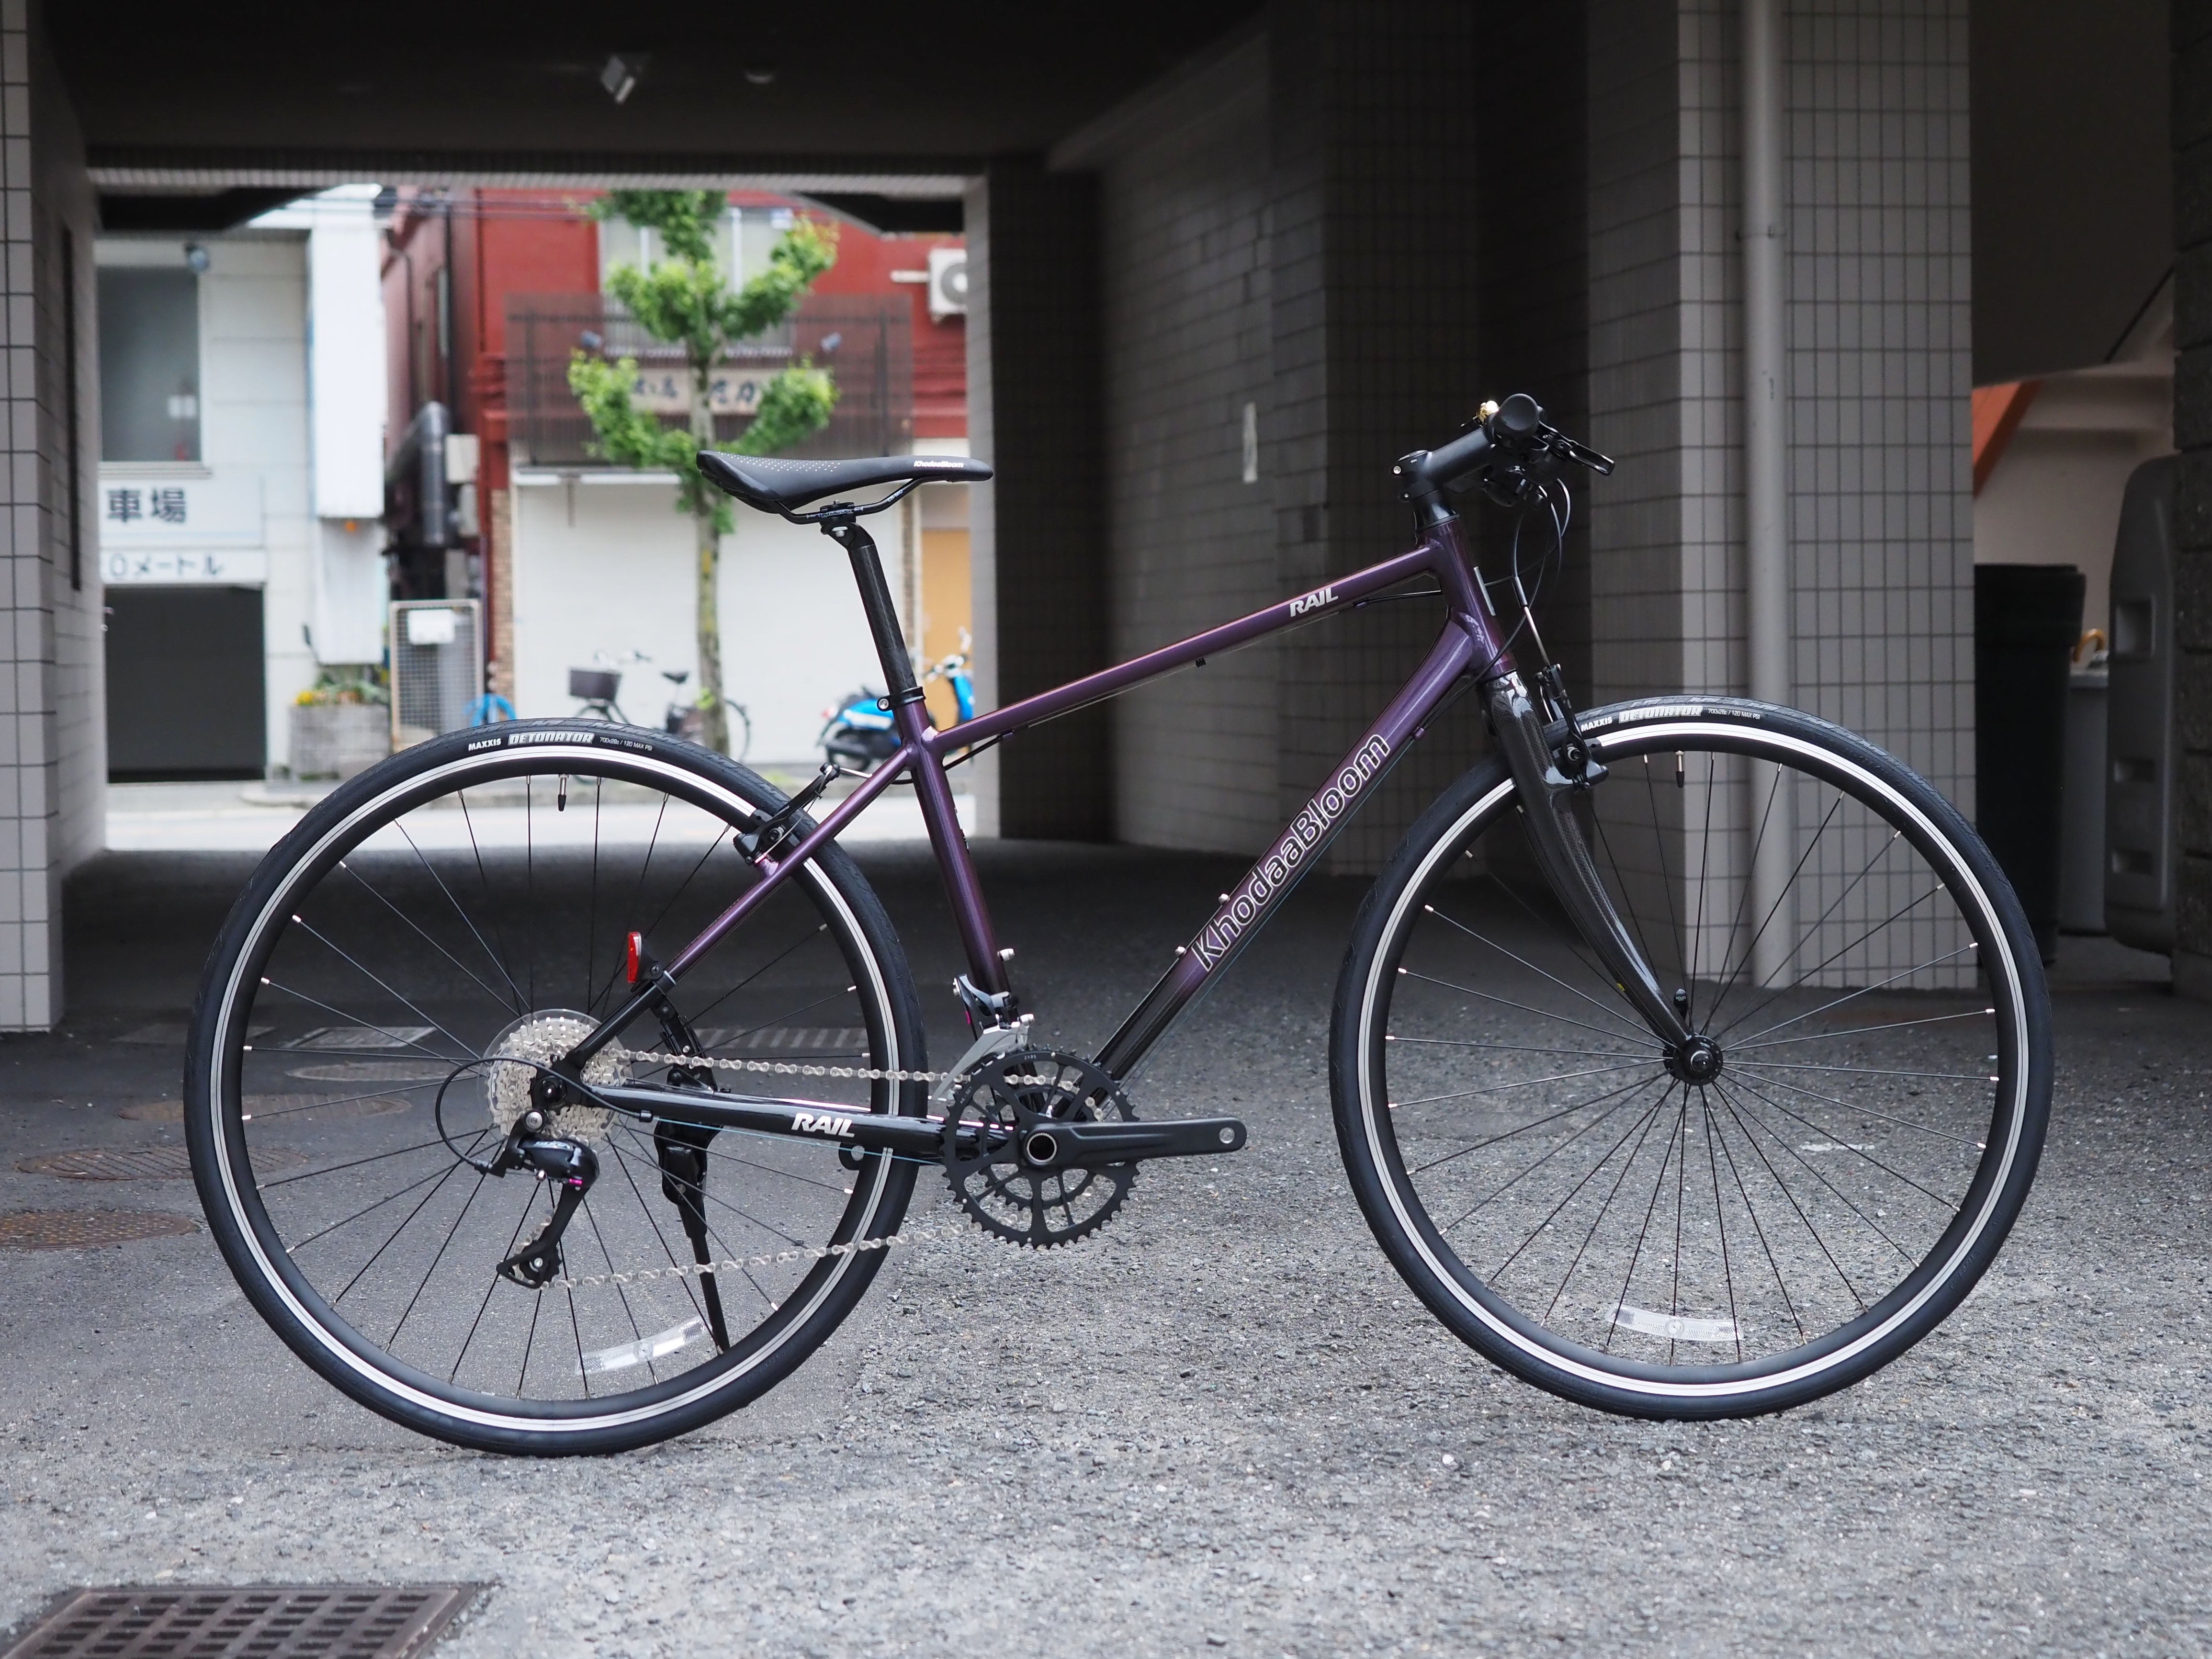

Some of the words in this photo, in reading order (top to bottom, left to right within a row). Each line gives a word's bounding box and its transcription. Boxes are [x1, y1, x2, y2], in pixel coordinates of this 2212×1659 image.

[1289, 587, 1339, 617] RAIL
[1580, 716, 1613, 732] MAXXIS
[1619, 706, 1704, 723] DETONATOR
[468, 738, 501, 751] MAXXIS
[508, 731, 595, 746] DETONATOR
[1191, 734, 1390, 972] KhodaaBloom
[791, 1113, 855, 1138] RAIL
